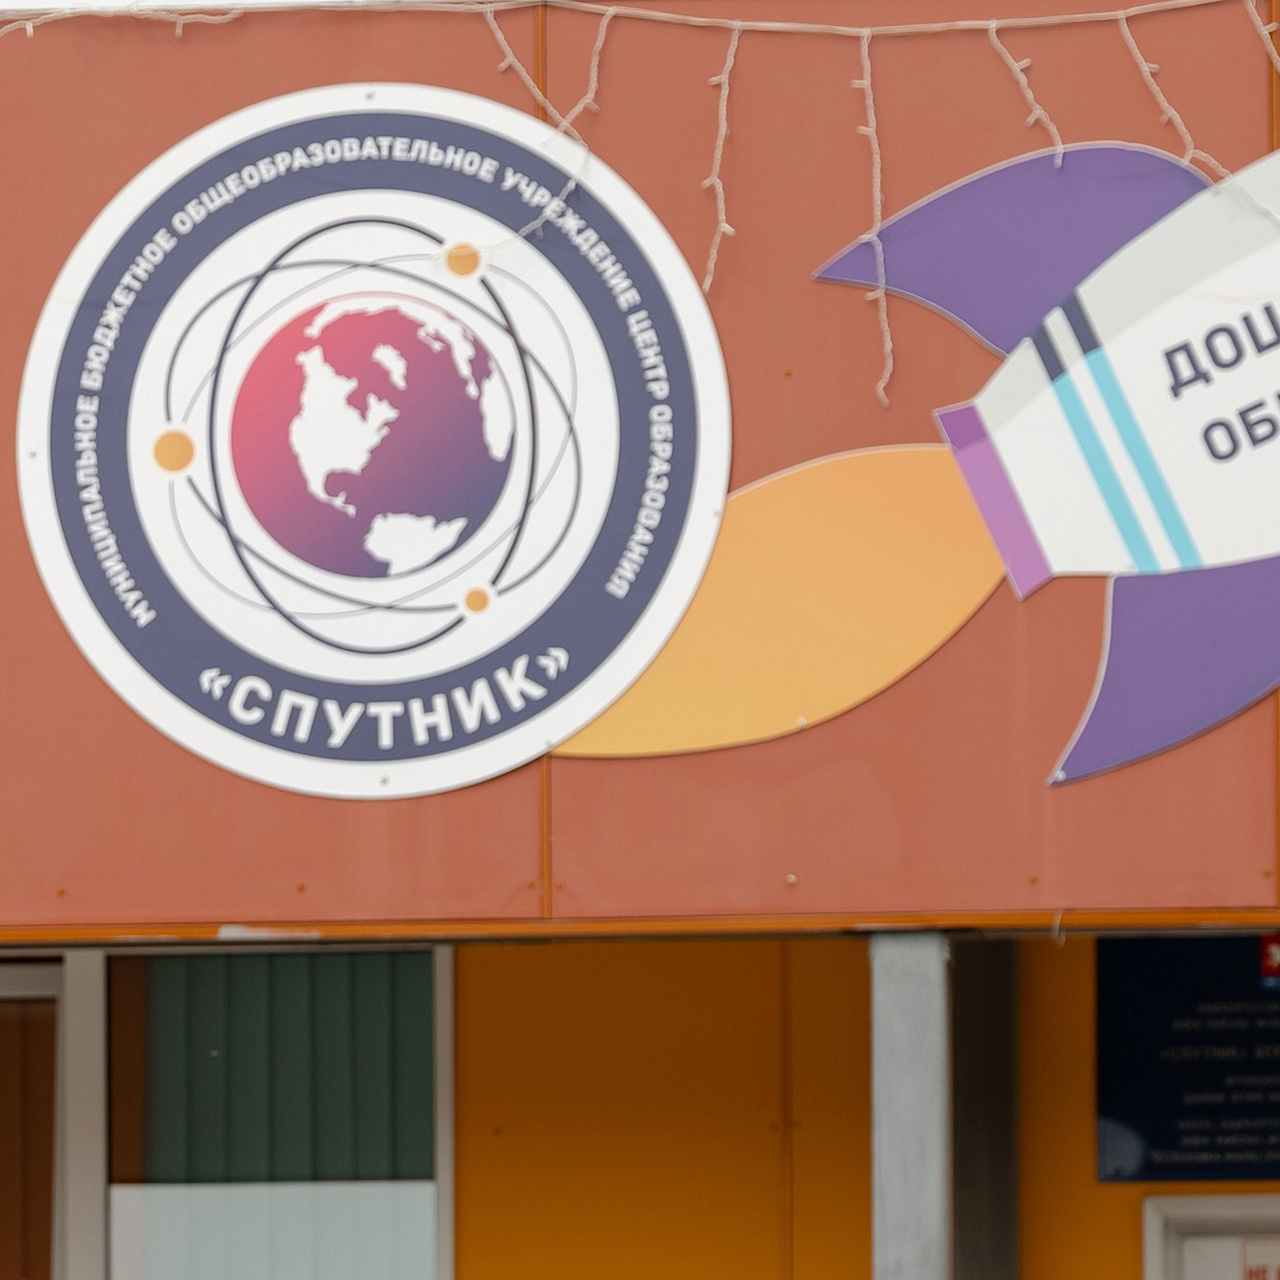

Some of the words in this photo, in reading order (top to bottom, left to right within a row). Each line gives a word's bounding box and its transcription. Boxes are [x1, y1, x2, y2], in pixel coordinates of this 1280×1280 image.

[171, 136, 500, 235] ОБЩЕОБРАЗОВАТЕЛЬНОЕ
[501, 166, 642, 312] УЧРЕЖДЕНИЕ
[80, 227, 178, 391] БЮДЖЕТНОЕ
[627, 309, 670, 400] ЦЕНТР
[74, 394, 157, 628] МУНИЦИПАЛЬНОЕ
[606, 404, 674, 599] ОБРАЗОВАНИЯ
[199, 647, 569, 749] «СПУТНИК»
